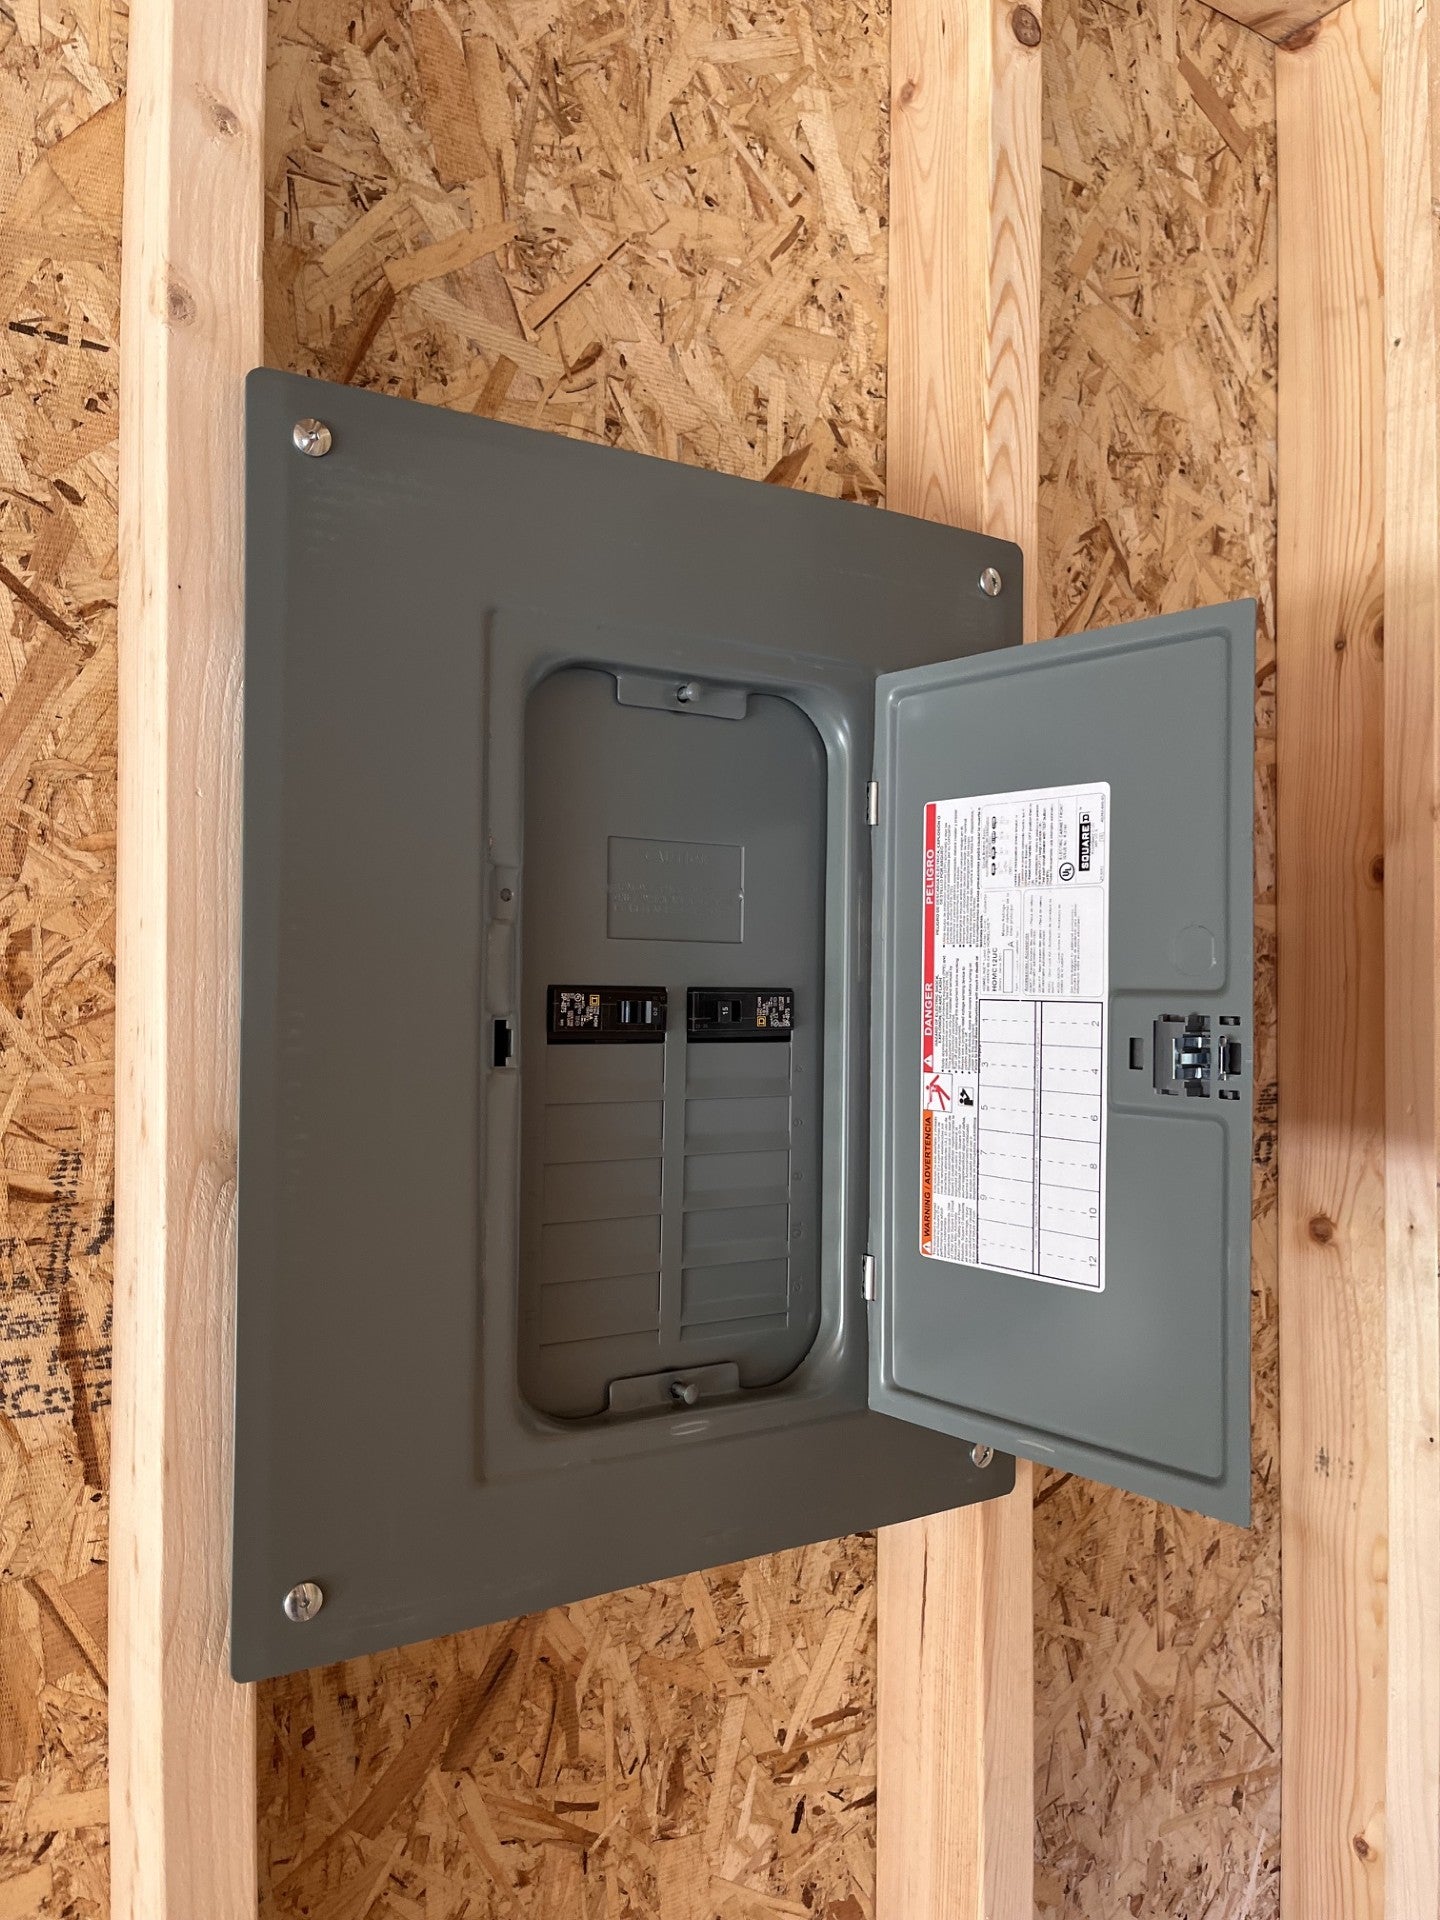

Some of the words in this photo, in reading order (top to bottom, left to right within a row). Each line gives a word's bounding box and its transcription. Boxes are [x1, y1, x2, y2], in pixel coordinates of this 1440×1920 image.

[1081, 824, 1089, 869] SQUARE
[722, 1006, 729, 1015] 15
[924, 982, 932, 1035] DANGER
[1090, 1067, 1099, 1075] 4
[1090, 1114, 1098, 1122] 6
[1089, 1162, 1098, 1170] 8
[1089, 1206, 1097, 1220] 10
[1088, 1254, 1097, 1269] 12
